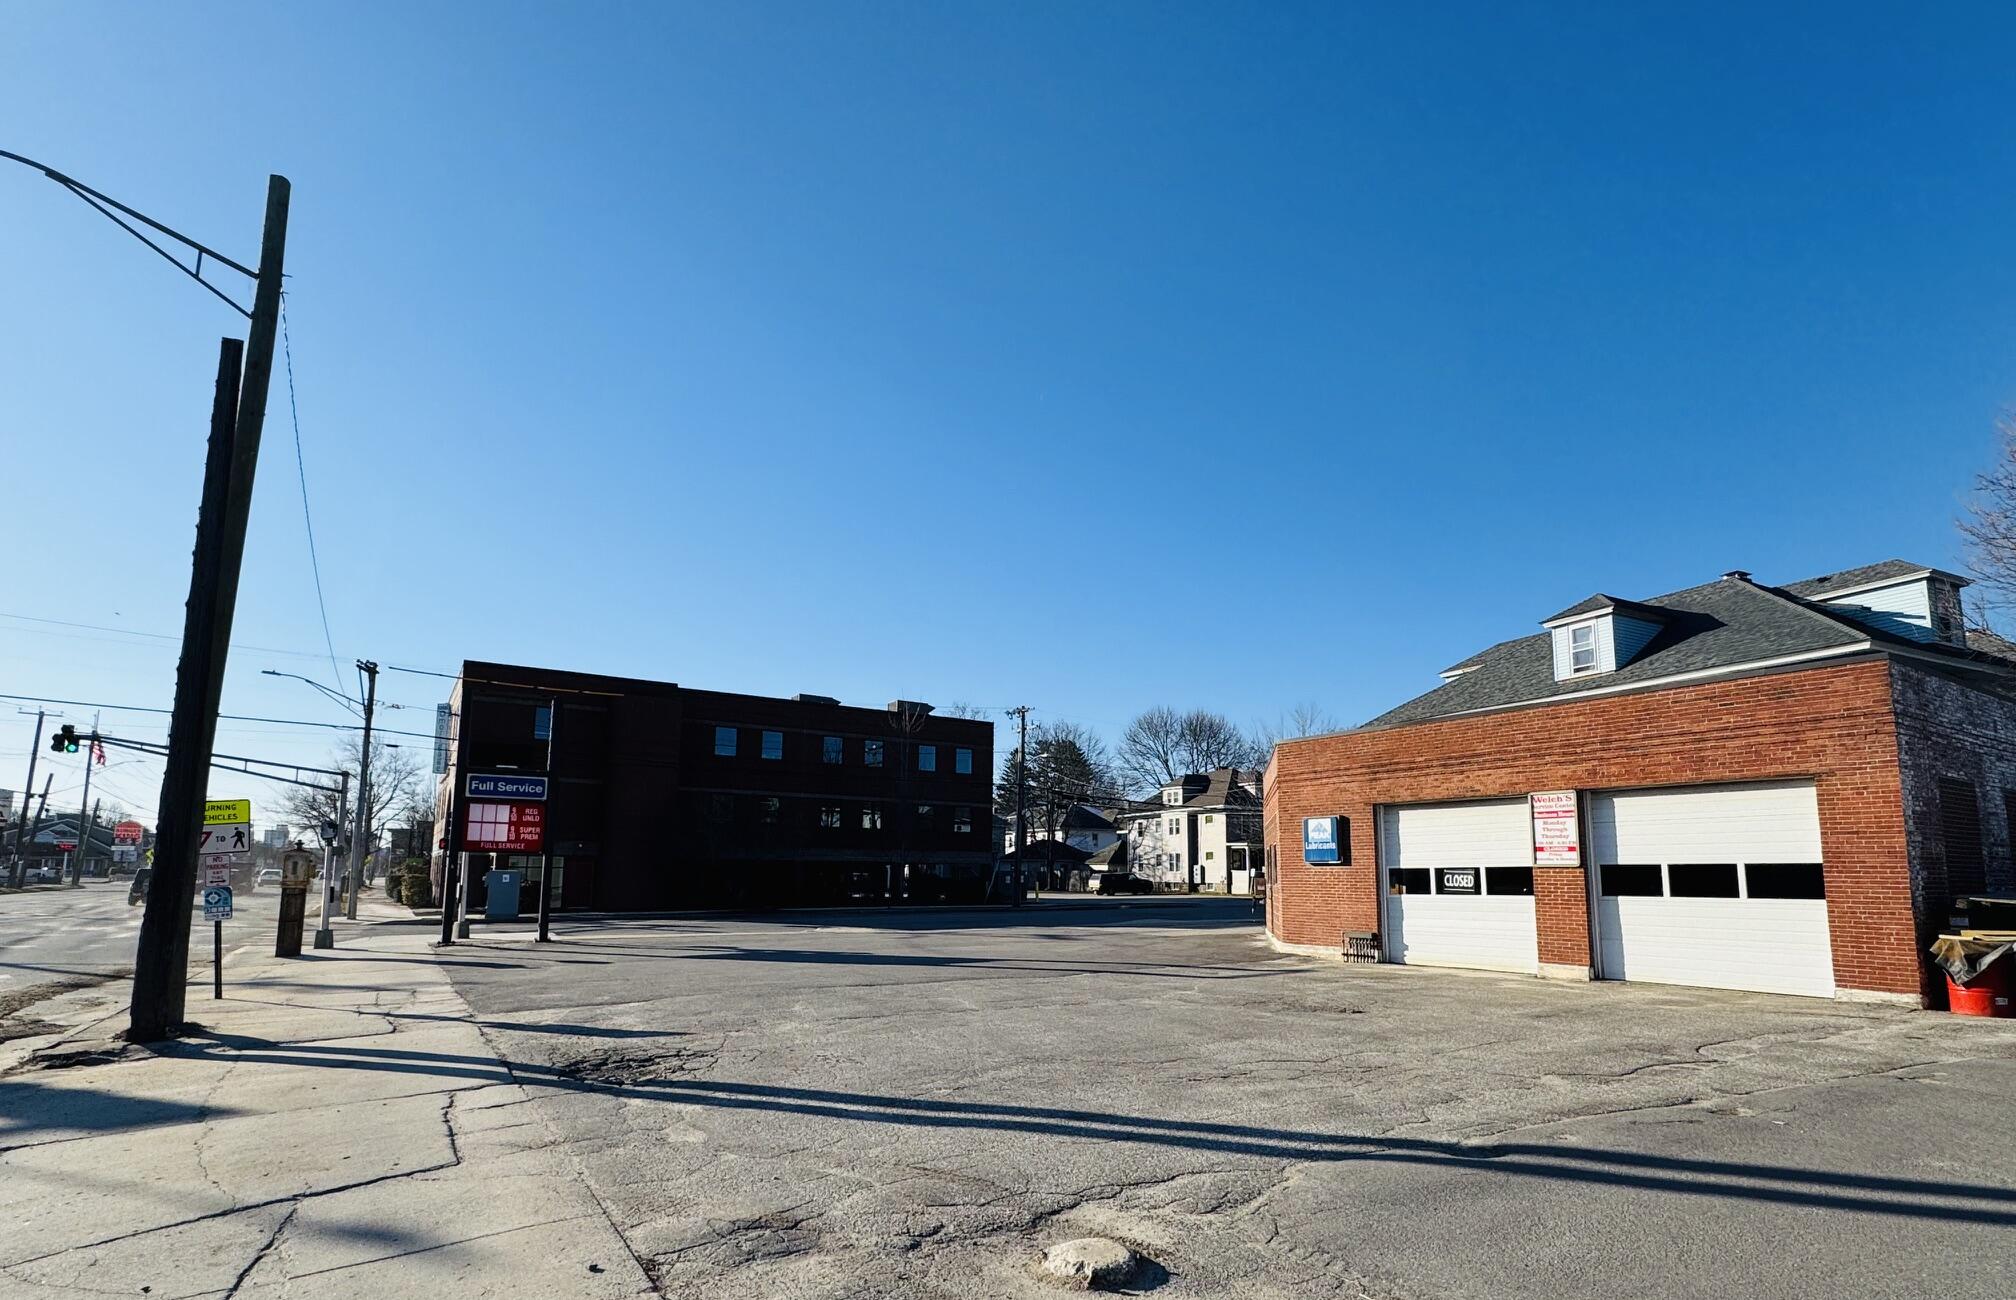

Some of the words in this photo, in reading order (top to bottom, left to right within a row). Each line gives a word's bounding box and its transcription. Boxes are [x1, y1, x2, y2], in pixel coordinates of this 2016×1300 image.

[471, 781, 494, 791] Full
[497, 782, 543, 793] Service
[204, 813, 239, 821] EHICLES
[1444, 874, 1475, 887] CLOSED
